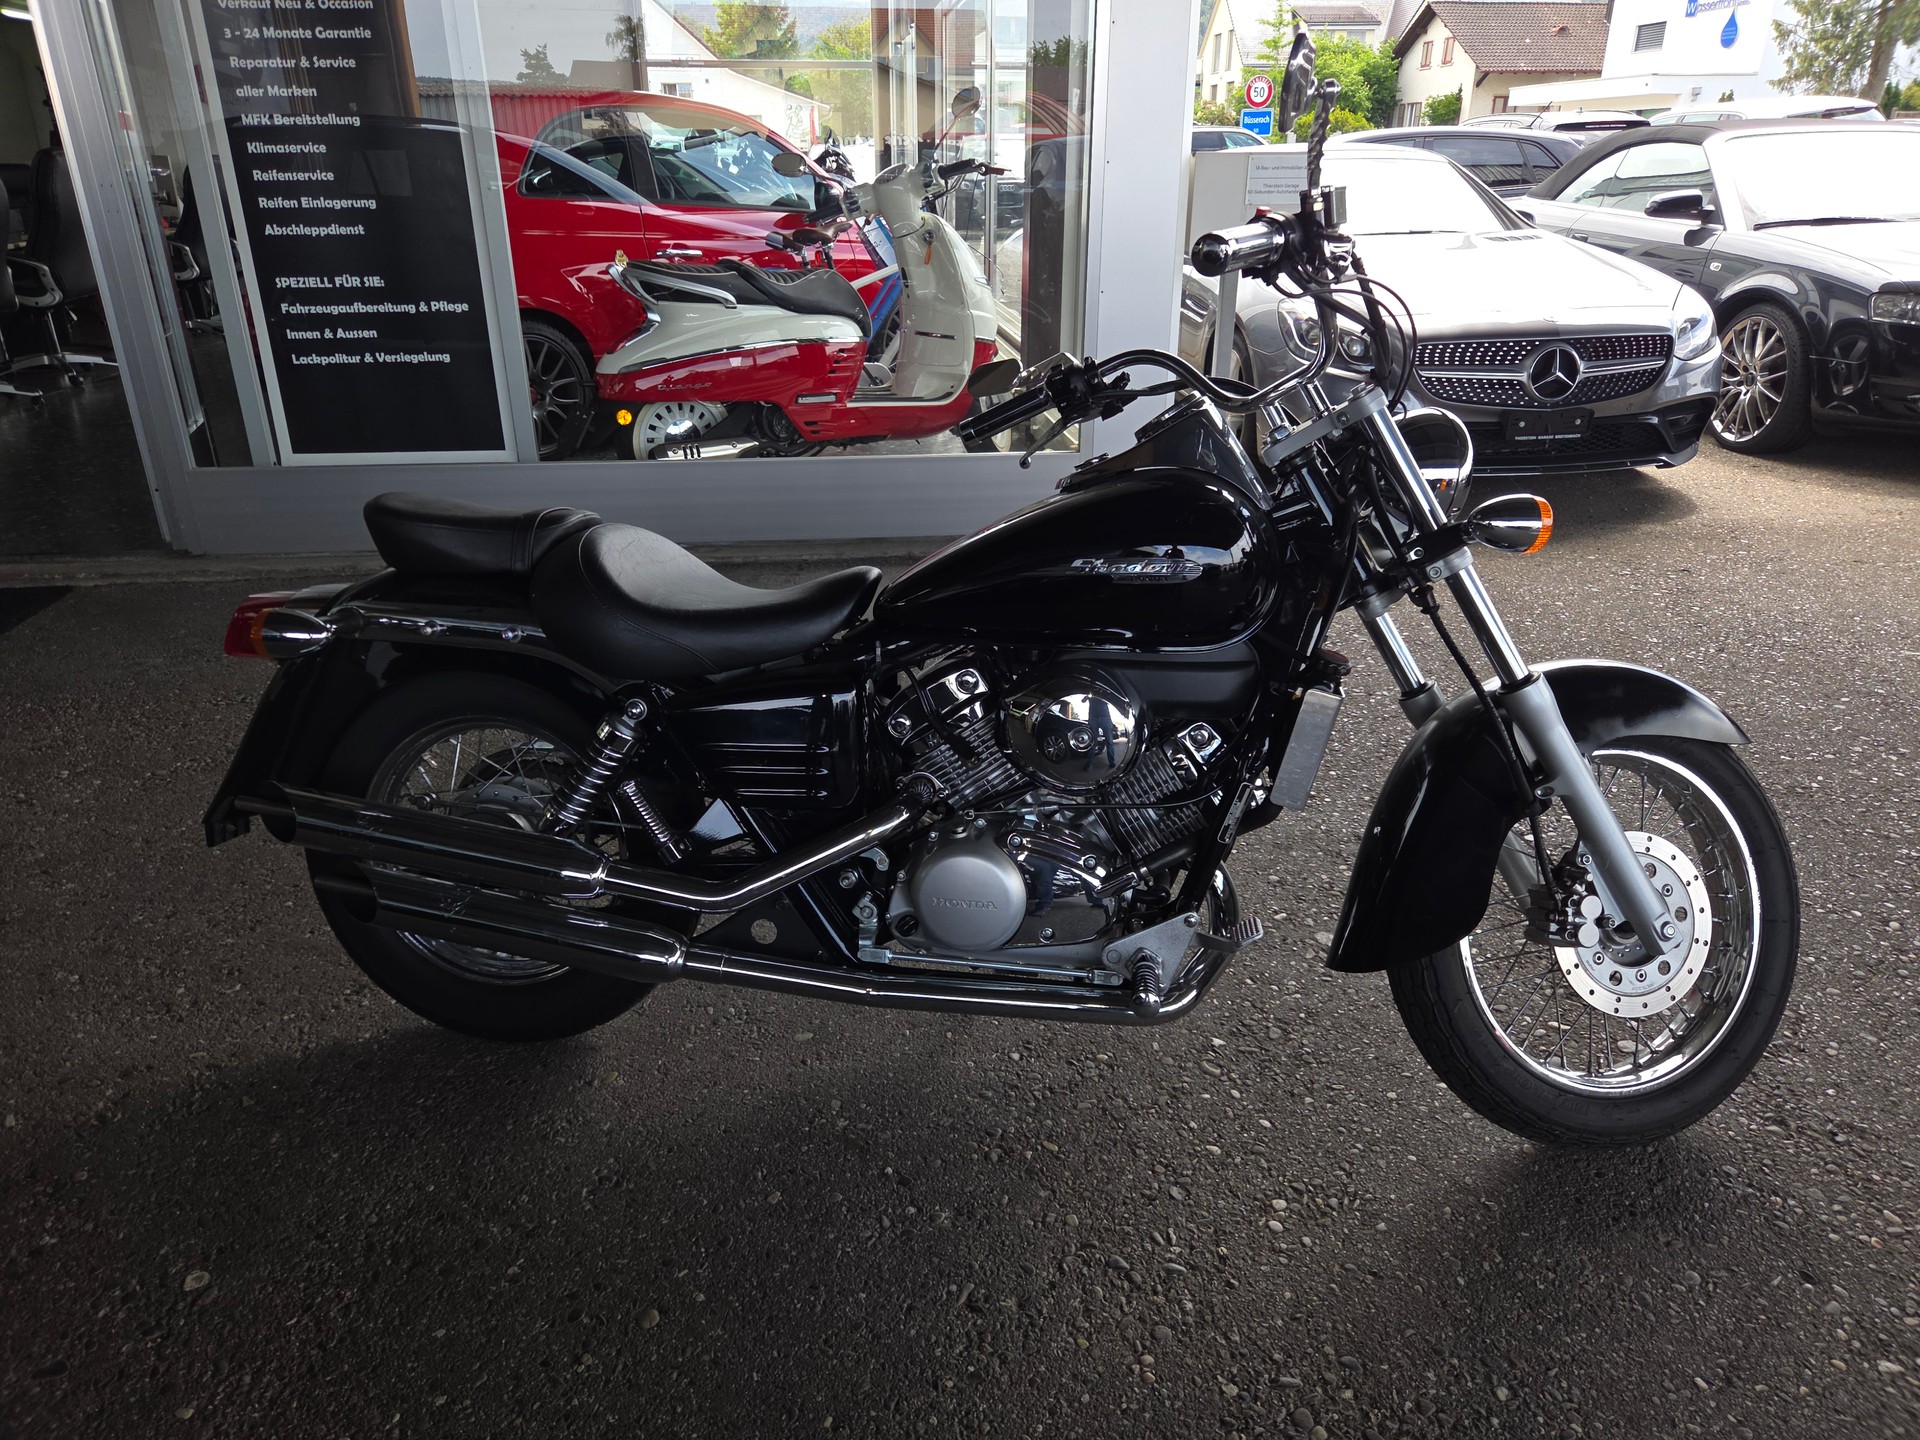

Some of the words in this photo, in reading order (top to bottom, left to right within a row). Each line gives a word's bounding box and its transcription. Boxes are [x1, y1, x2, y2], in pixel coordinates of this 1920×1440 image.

[274, 0, 302, 9] Neu
[304, 0, 316, 9] &
[317, 0, 374, 9] Occasion
[223, 28, 232, 38] 3
[243, 28, 260, 38] 24
[262, 26, 313, 38] Monate
[314, 26, 372, 38] Garantie
[229, 56, 297, 70] Reparatur
[299, 55, 311, 68] &
[312, 55, 357, 68] Service
[235, 84, 265, 97] aller
[266, 84, 318, 97] Marken
[1253, 87, 1265, 98] 50
[240, 113, 272, 126] MFK
[273, 112, 361, 127] Bereitstellung
[246, 141, 327, 154] Klimaservice
[252, 168, 335, 182] Reifenservice
[257, 196, 298, 209] Reifen
[300, 195, 377, 210] Einlagerung
[264, 223, 366, 238] Abschleppdienst
[274, 276, 333, 289] SPEZIELL
[334, 273, 362, 288] FÜR
[363, 275, 385, 288] SIE:
[280, 301, 416, 316] Fahrzeugaufbereitung
[418, 301, 429, 313] &
[430, 300, 469, 314] Pflege
[285, 328, 322, 340] Innen
[323, 327, 335, 339] &
[336, 327, 378, 339] Aussen
[291, 352, 362, 366] Lackpolitur
[363, 352, 375, 364] &
[375, 351, 451, 365] Versiegelung
[931, 897, 998, 910] HONDA
